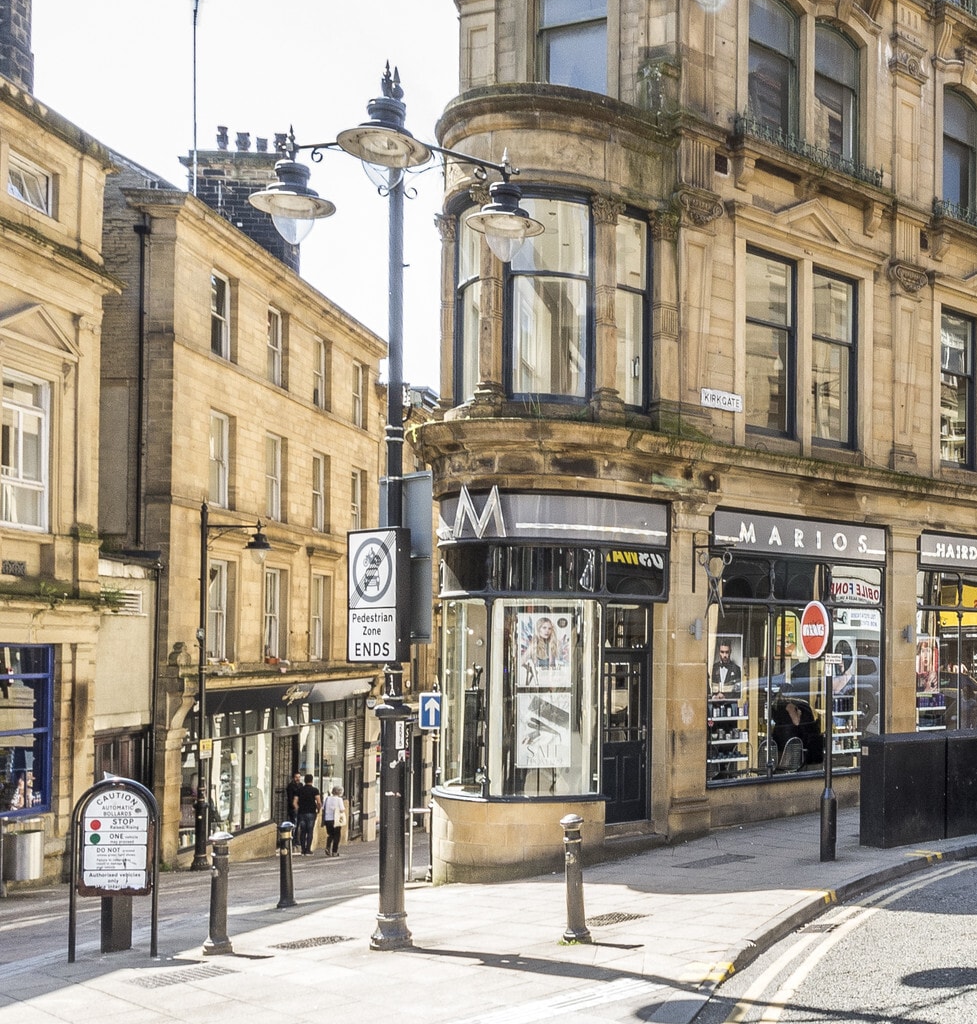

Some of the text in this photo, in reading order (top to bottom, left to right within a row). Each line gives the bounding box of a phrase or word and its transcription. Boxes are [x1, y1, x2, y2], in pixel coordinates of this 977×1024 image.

[704, 392, 740, 408] KIRKGATE
[452, 484, 507, 539] M
[739, 521, 868, 554] MARIOS
[352, 612, 393, 623] Pedestrian
[362, 625, 382, 636] Zone
[355, 642, 390, 657] ENDS
[96, 792, 138, 806] CAUTION
